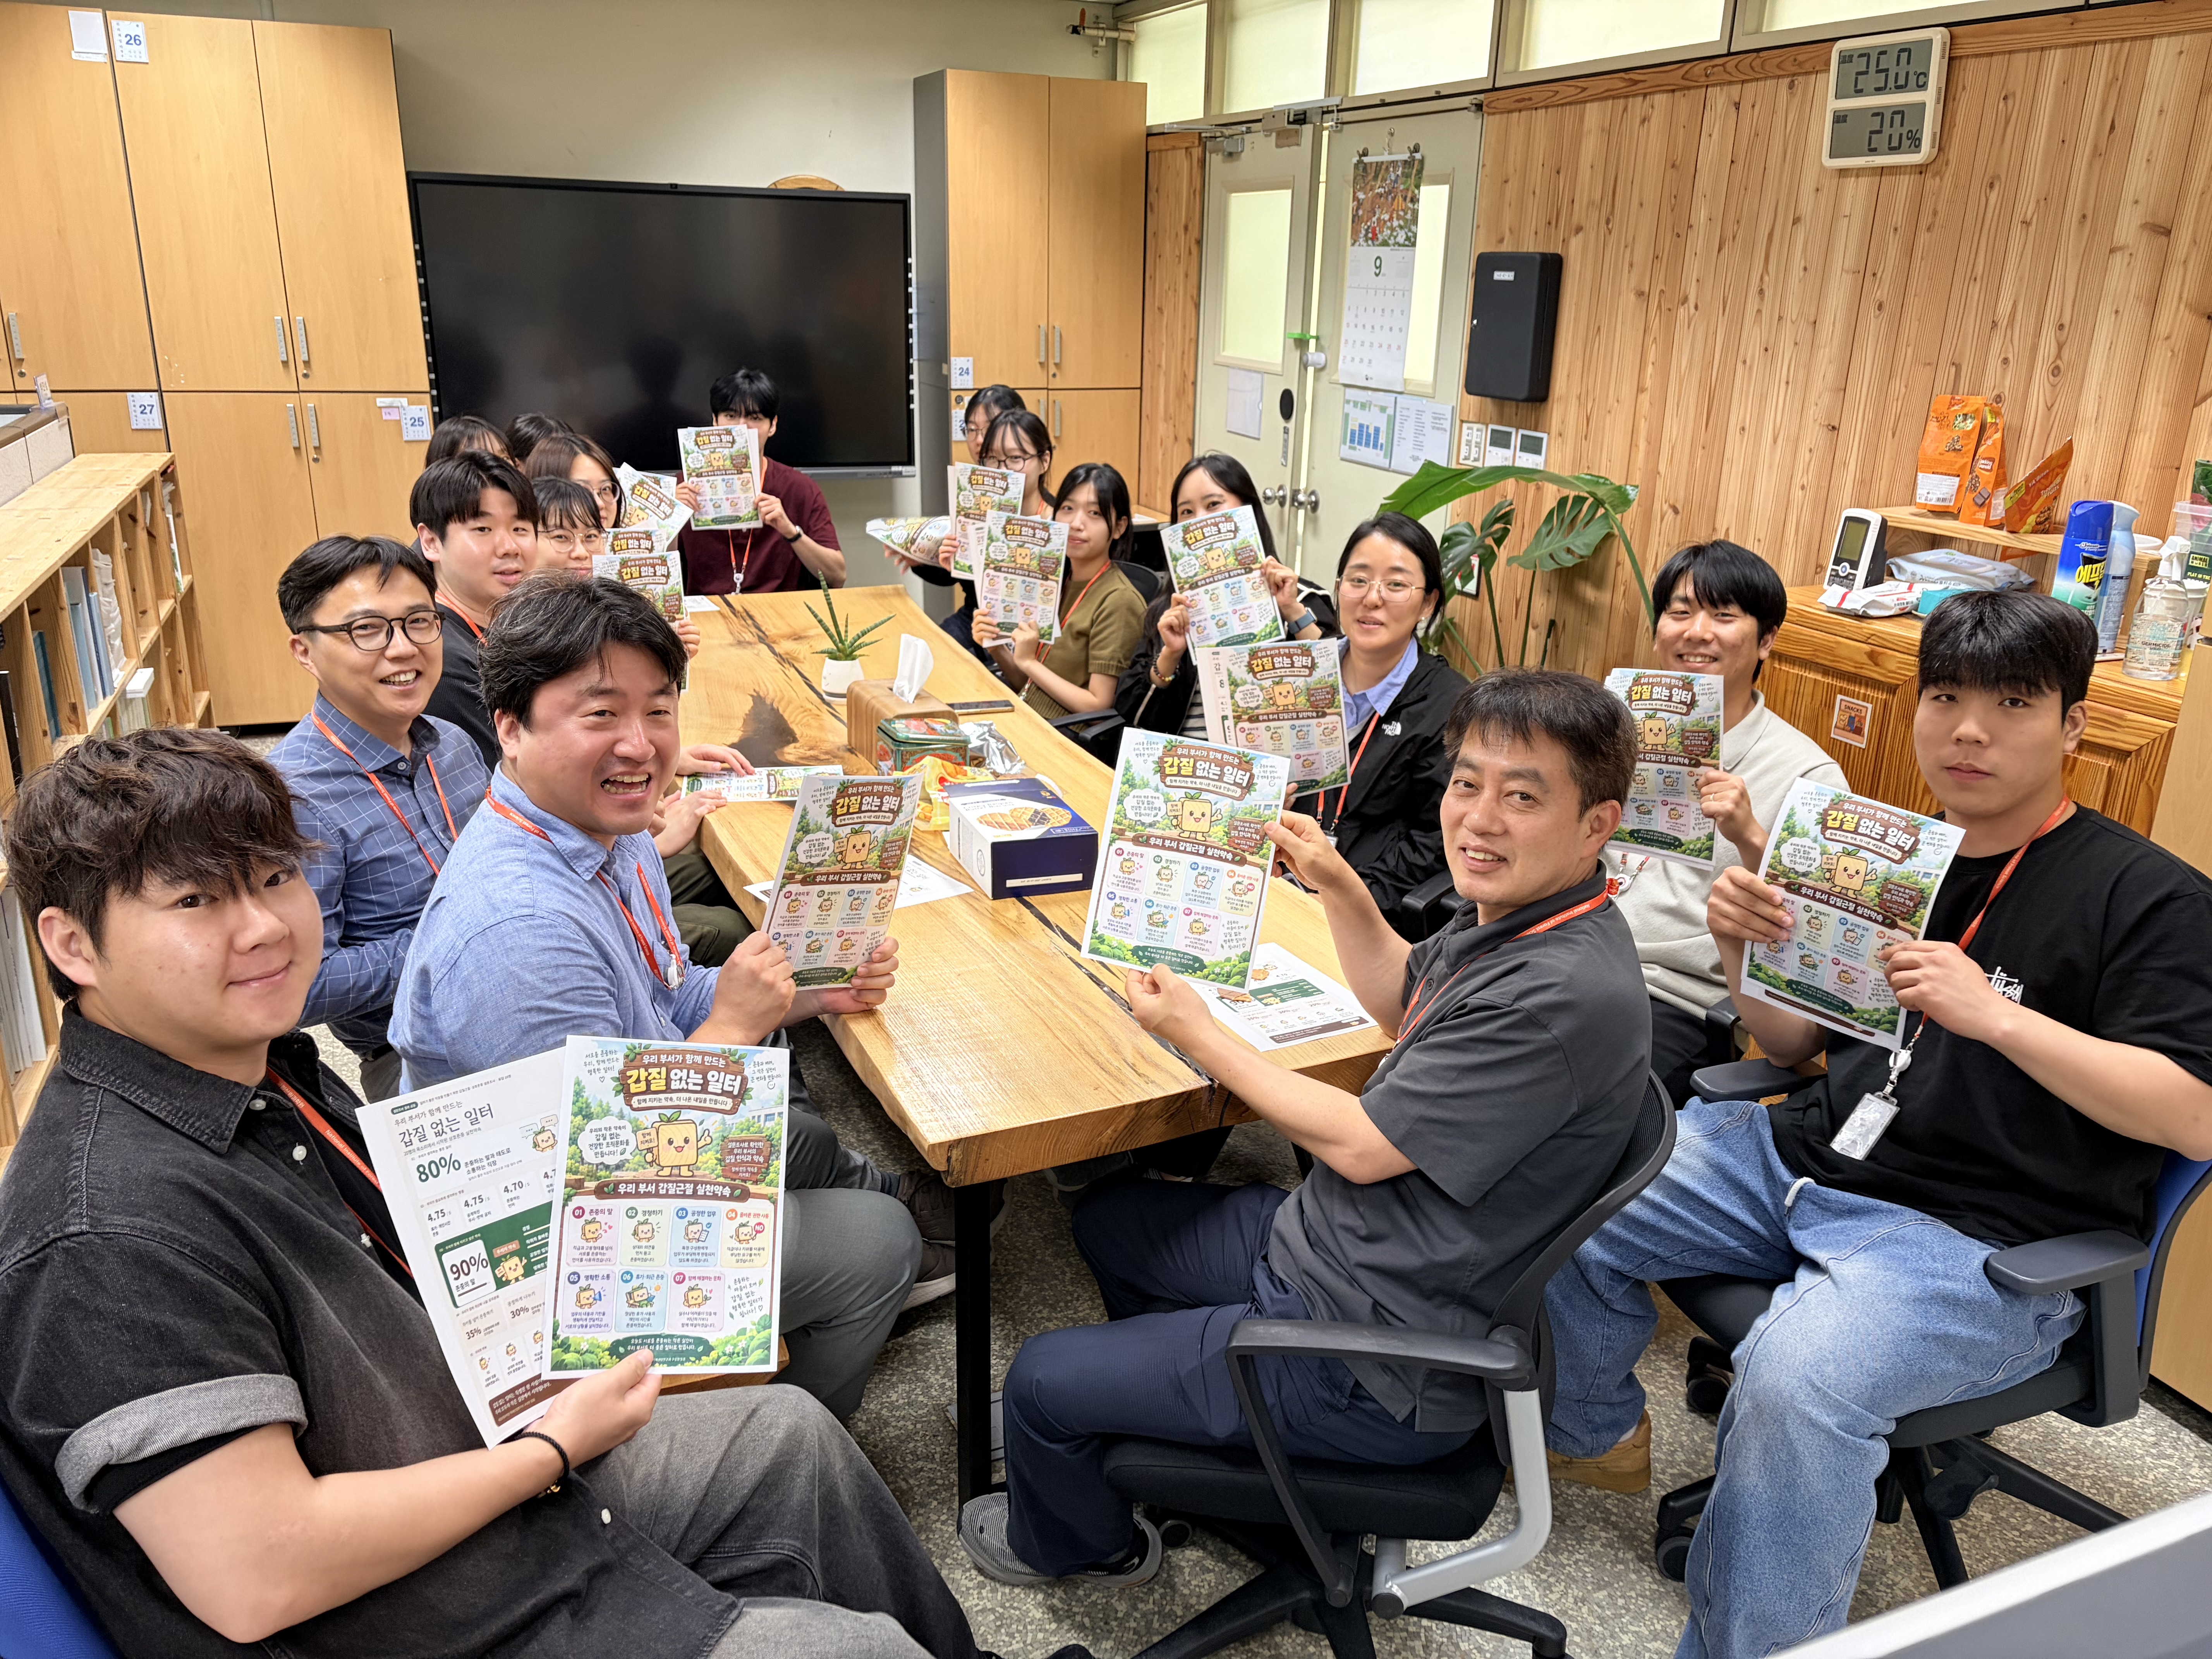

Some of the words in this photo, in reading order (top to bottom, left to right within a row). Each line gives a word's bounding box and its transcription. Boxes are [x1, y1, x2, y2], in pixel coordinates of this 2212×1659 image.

[125, 34, 142, 46] 26
[1868, 110, 1921, 152] 20%
[1374, 256, 1382, 277] 9
[958, 367, 970, 376] 24
[139, 404, 155, 414] 27
[410, 417, 424, 427] 25
[1185, 529, 1204, 544] 갑질
[1203, 525, 1219, 538] 없는
[1219, 520, 1236, 534] 일터
[613, 539, 627, 551] 갑질
[628, 539, 639, 549] 없는
[640, 539, 651, 549] 일터
[621, 566, 639, 580] 갑질
[641, 566, 654, 577] 없는
[655, 566, 668, 577] 일터
[1250, 657, 1273, 672] 갑질
[1273, 656, 1292, 669] 없는
[1293, 655, 1312, 668] 일터
[1631, 685, 1651, 700] 갑질
[1652, 686, 1670, 701] 없는
[1672, 689, 1692, 704] 일터
[1844, 704, 1862, 714] SNACKS
[1176, 747, 1188, 756] 우리
[1189, 749, 1207, 759] 부서가
[1209, 751, 1222, 760] 함께
[1223, 754, 1240, 765] 만드는
[1162, 754, 1194, 778] 갑질
[1195, 760, 1222, 781] 없는
[1222, 766, 1250, 788] 일터
[836, 796, 862, 814] 갑질
[862, 796, 881, 812] 없는
[883, 795, 899, 812] 일터
[1827, 810, 1857, 831] 갑질
[1858, 818, 1884, 839] 없는
[1887, 827, 1916, 850] 일터
[1149, 837, 1163, 846] 우리
[1164, 840, 1177, 849] 부서
[1178, 842, 1205, 854] 갑질근절
[1207, 847, 1233, 860] 실천약속
[1573, 903, 1590, 914] National
[1555, 911, 1574, 922] Institute
[642, 1054, 658, 1065] 우리
[659, 1054, 683, 1065] 부서가
[685, 1054, 702, 1065] 함께
[704, 1055, 726, 1067] 만드는
[625, 1065, 666, 1094] 갑질
[669, 1068, 704, 1093] 없는
[706, 1071, 742, 1096] 일터
[708, 1098, 728, 1106] 만듭니다
[393, 1117, 407, 1127] 우리
[407, 1111, 427, 1122] 부서가
[428, 1107, 442, 1116] 함께
[442, 1100, 463, 1111] 만드는
[397, 1125, 429, 1147] 갑질
[429, 1114, 462, 1137] 없는
[463, 1104, 495, 1126] 일터
[595, 1132, 607, 1141] 갑질
[325, 1129, 344, 1148] National
[343, 1147, 361, 1166] Institute
[588, 1142, 603, 1151] 건강한
[605, 1139, 629, 1148] 조직문화를
[464, 1157, 484, 1167] 존중하는
[495, 1148, 512, 1156] 태도로
[594, 1149, 618, 1158] 만듭니다!
[414, 1153, 462, 1182] 80%
[465, 1164, 486, 1174] 소통하는
[502, 1180, 524, 1194] 4.70
[617, 1183, 635, 1194] 우리
[637, 1184, 656, 1194] 부서
[658, 1183, 694, 1195] 갑질근절
[696, 1184, 731, 1197] 실천약속
[462, 1195, 484, 1209] 4.75
[426, 1209, 447, 1222] 4.75
[447, 1252, 490, 1280] 90%
[454, 1281, 470, 1291] 존중의
[509, 1305, 530, 1318] 30%
[465, 1327, 483, 1340] 35%
